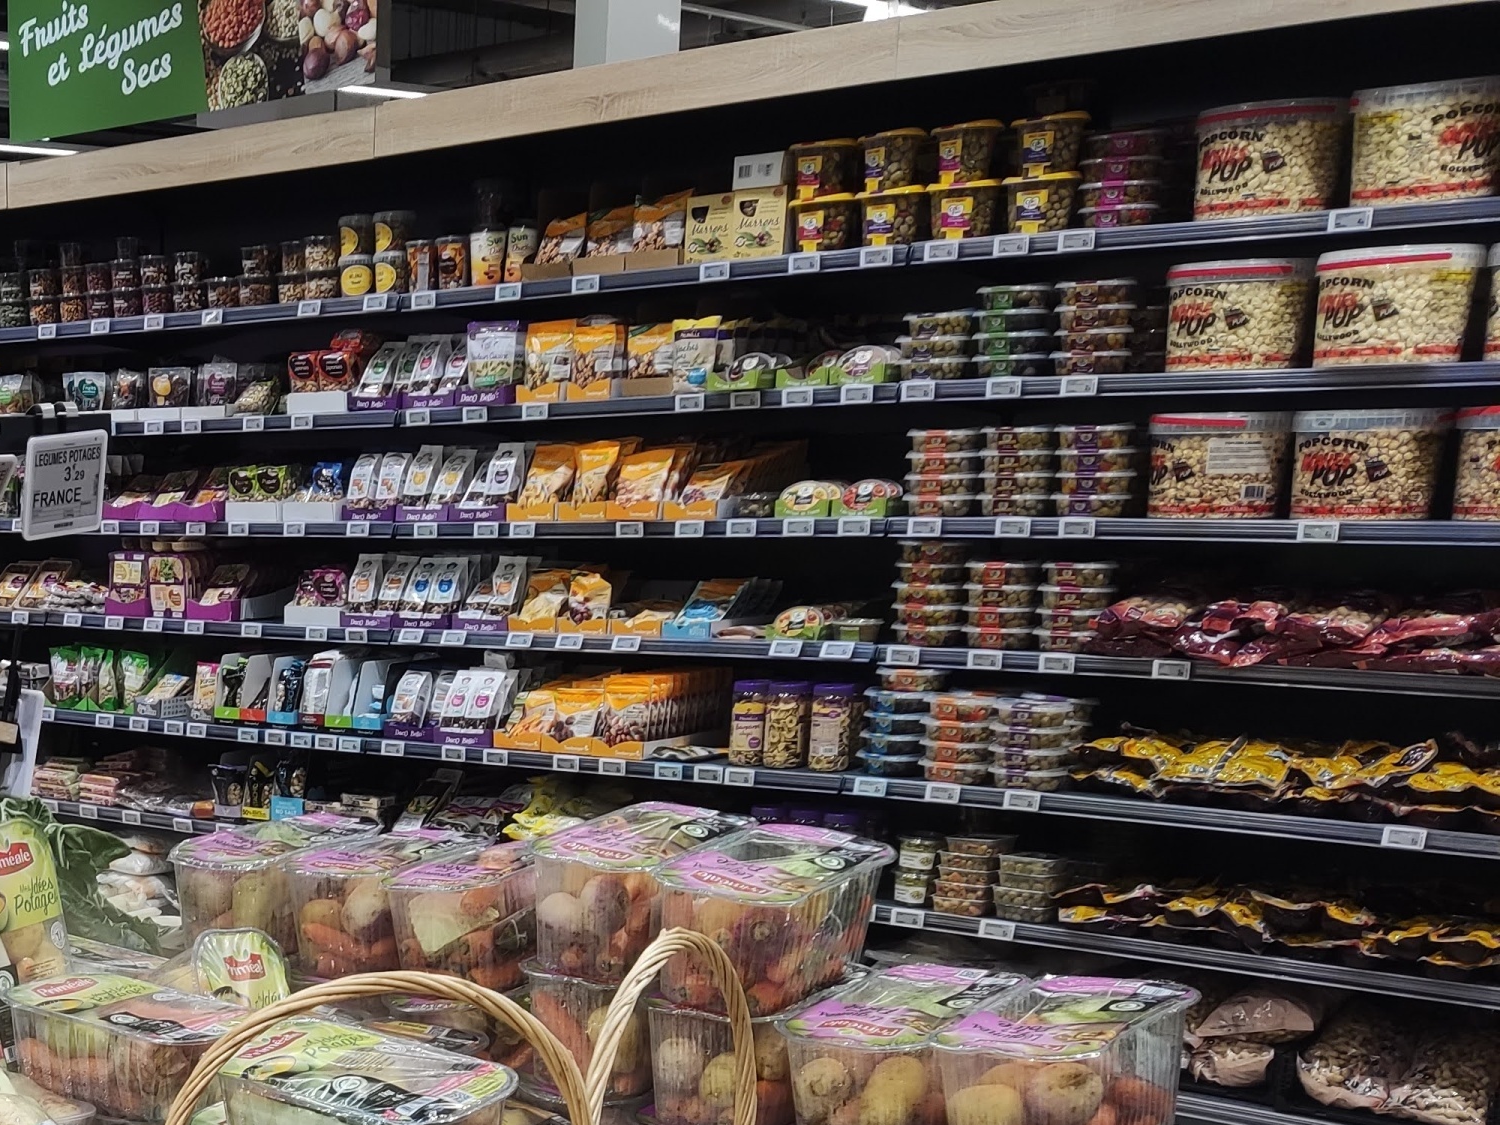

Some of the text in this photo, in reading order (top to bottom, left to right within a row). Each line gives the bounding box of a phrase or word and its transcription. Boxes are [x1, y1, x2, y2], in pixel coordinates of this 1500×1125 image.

[19, 0, 89, 57] Fruits
[48, 3, 183, 86] et Légumes
[121, 53, 172, 95] Secs
[1431, 102, 1500, 125] POPCO
[1208, 156, 1253, 184] POP
[1320, 277, 1375, 290] OPCORN
[1177, 313, 1217, 336] POP
[1323, 304, 1363, 329] POP
[1299, 437, 1369, 451] POPCORN
[34, 446, 101, 467] LEGUMES POTAGES
[1310, 464, 1357, 487] POP
[33, 487, 82, 508] FRANCE
[36, 977, 96, 997] Priméale
